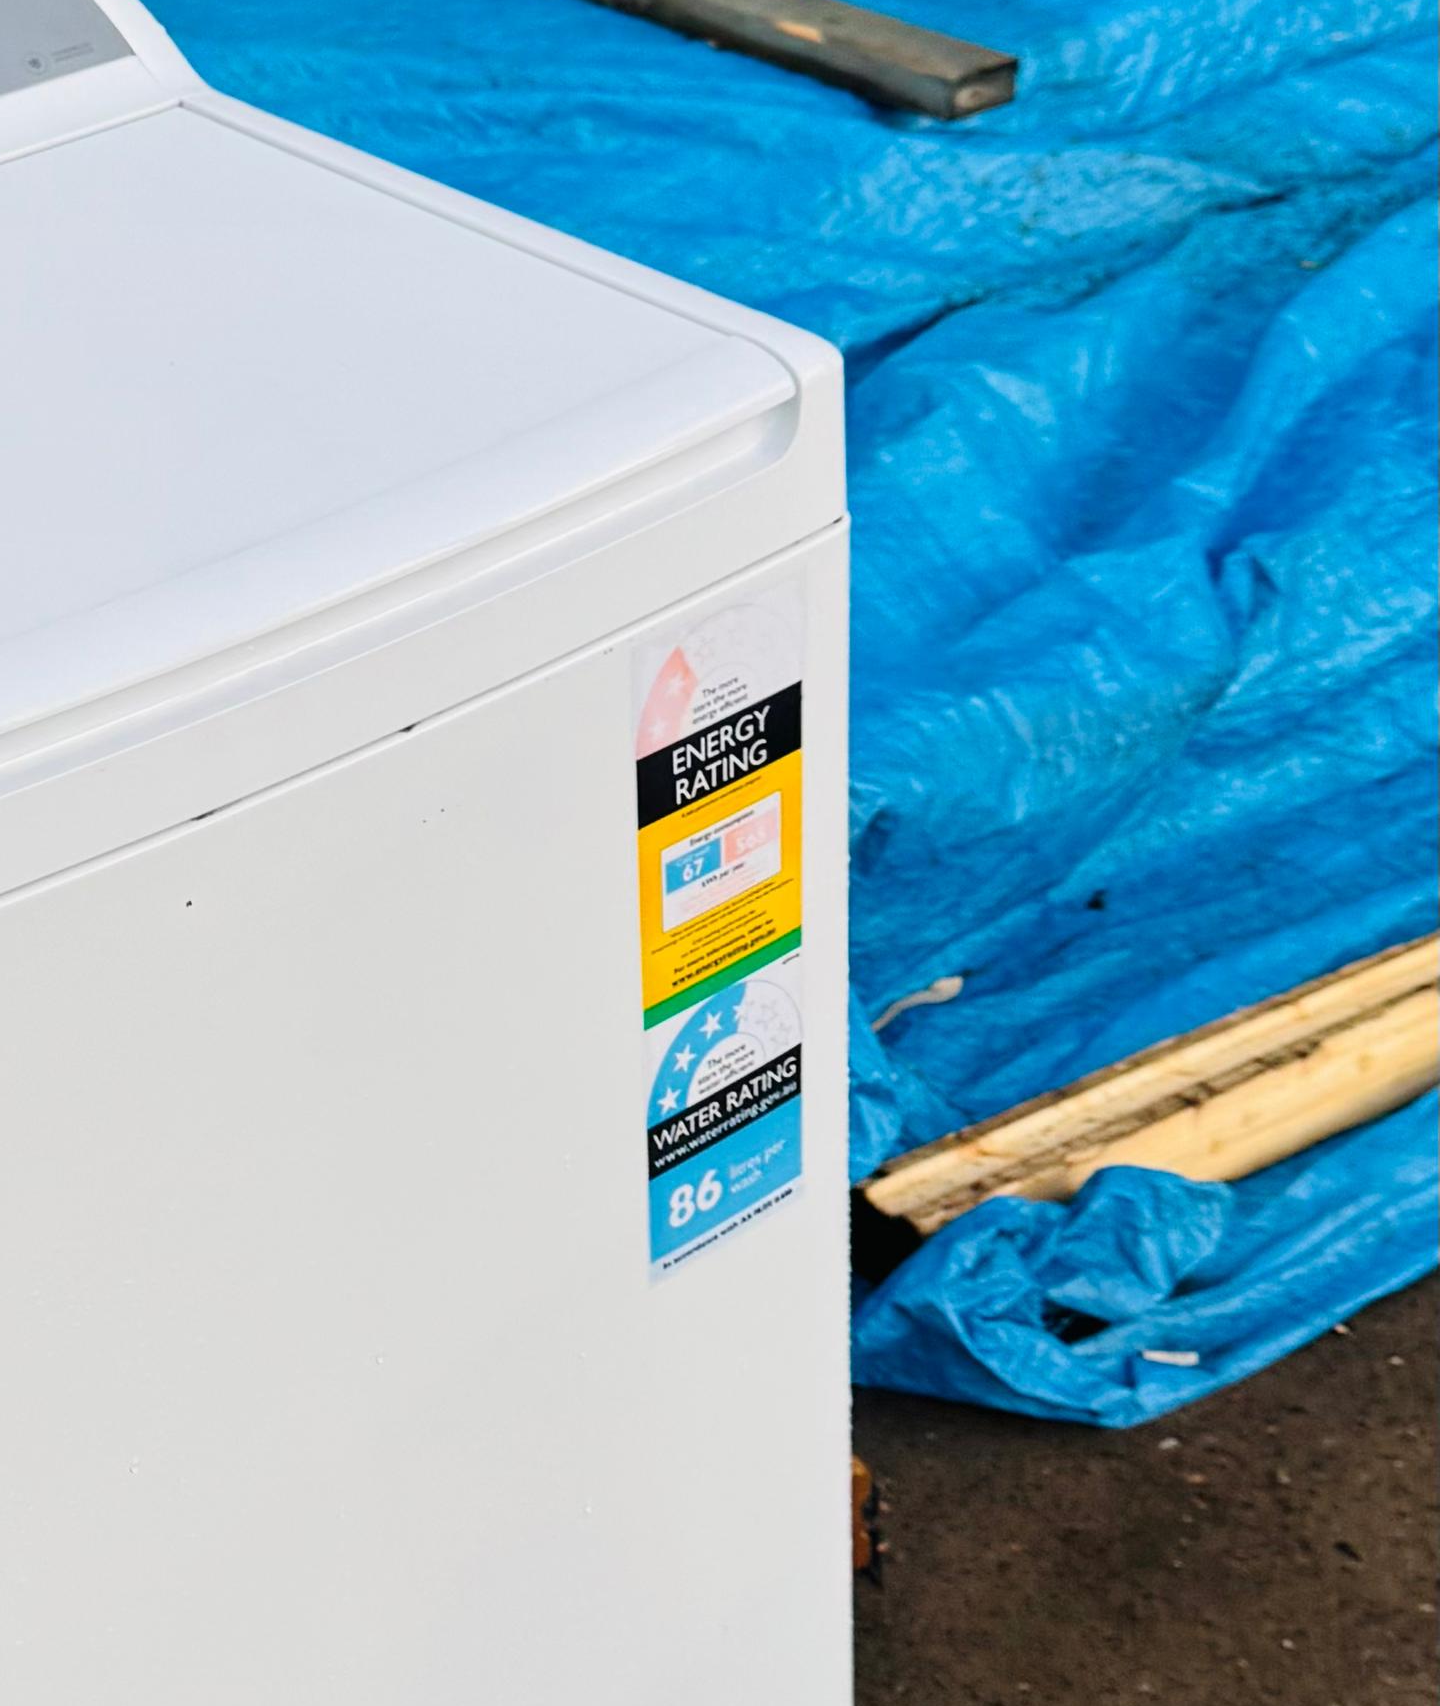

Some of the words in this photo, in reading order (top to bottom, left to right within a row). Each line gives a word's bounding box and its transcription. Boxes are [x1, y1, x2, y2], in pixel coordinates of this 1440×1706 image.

[672, 705, 771, 776] ENERGY
[676, 739, 768, 805] RATING
[683, 856, 704, 882] 67
[708, 1055, 723, 1069] The
[725, 1044, 747, 1060] more
[719, 1061, 733, 1074] the
[734, 1050, 756, 1065] more
[653, 1101, 723, 1151] WATER
[726, 1056, 799, 1113] RATING
[668, 1168, 724, 1229] 86
